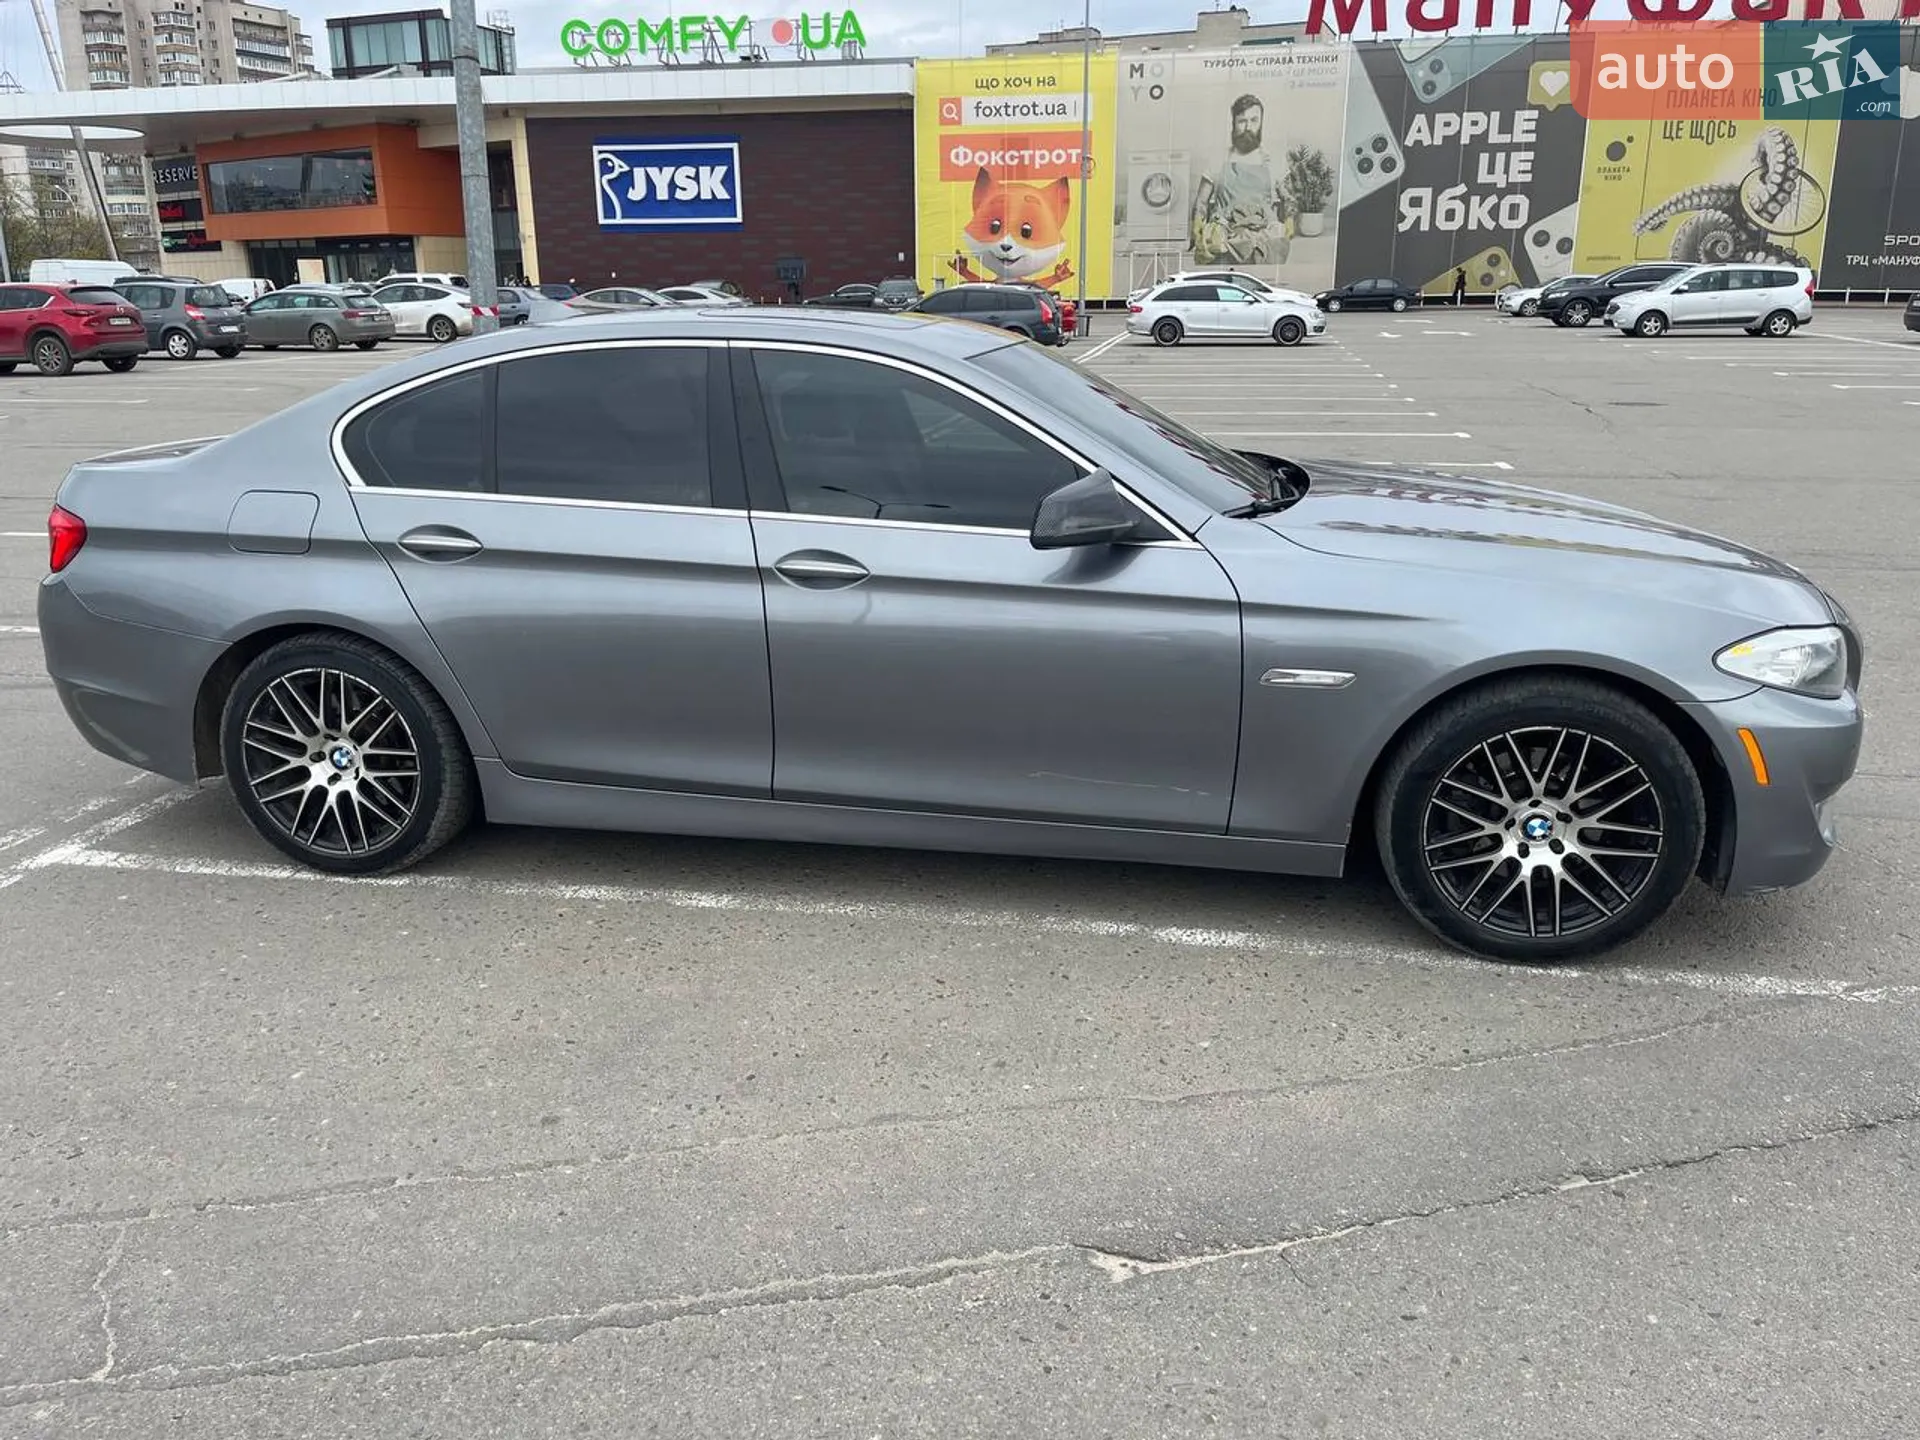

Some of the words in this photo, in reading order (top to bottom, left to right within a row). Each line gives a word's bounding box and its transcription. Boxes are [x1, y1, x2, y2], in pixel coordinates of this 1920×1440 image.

[560, 15, 748, 57] COMFY
[801, 10, 867, 50] UA
[1255, 56, 1295, 66] СПРАВА
[1296, 54, 1339, 64] ТЕХНІКИ
[974, 76, 1000, 90] що
[1003, 76, 1032, 88] хоч
[1036, 75, 1056, 87] на
[1666, 89, 1736, 109] ПЛАНЕТА
[1741, 87, 1777, 107] КІНО
[973, 101, 1067, 119] foxtrot.ua
[1404, 110, 1539, 147] APPLE
[950, 145, 1082, 169] Фокстрот
[1477, 151, 1535, 188] ЦЕ
[627, 165, 731, 201] JYSK
[1846, 255, 1869, 267] ТРЦ
